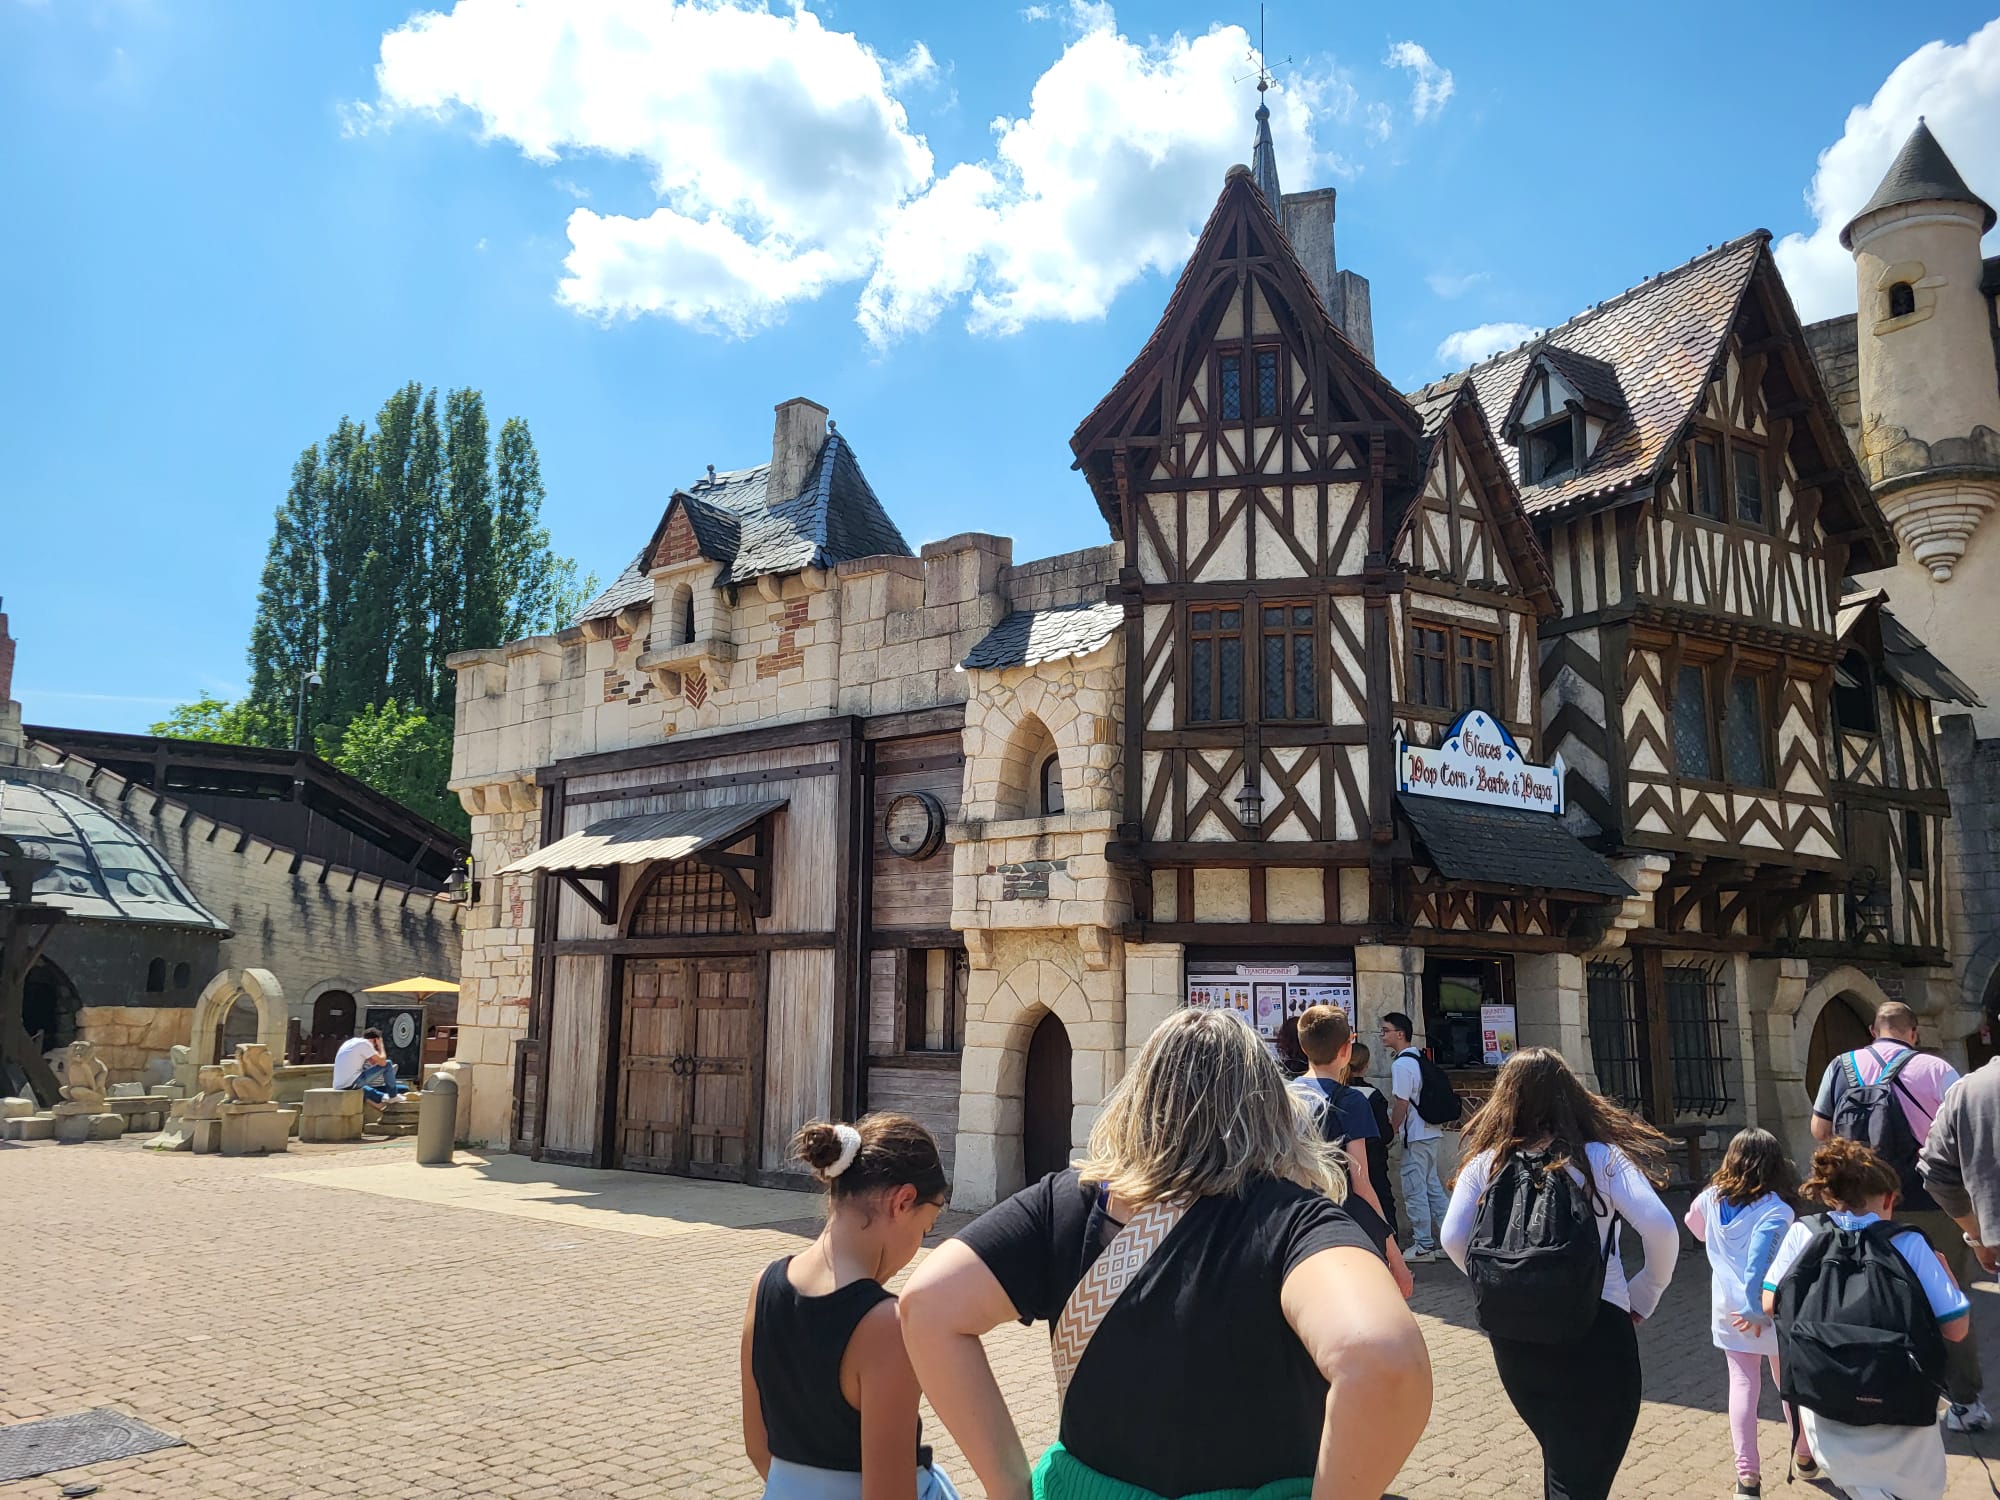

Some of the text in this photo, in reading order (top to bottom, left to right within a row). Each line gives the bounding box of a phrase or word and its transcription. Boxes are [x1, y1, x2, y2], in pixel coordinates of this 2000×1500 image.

[1462, 728, 1502, 760] Glaces
[1408, 754, 1438, 789] Pop
[1440, 762, 1467, 788] Corn
[1475, 765, 1510, 796] Barbe
[1512, 774, 1520, 796] à
[1520, 771, 1553, 804] Papa
